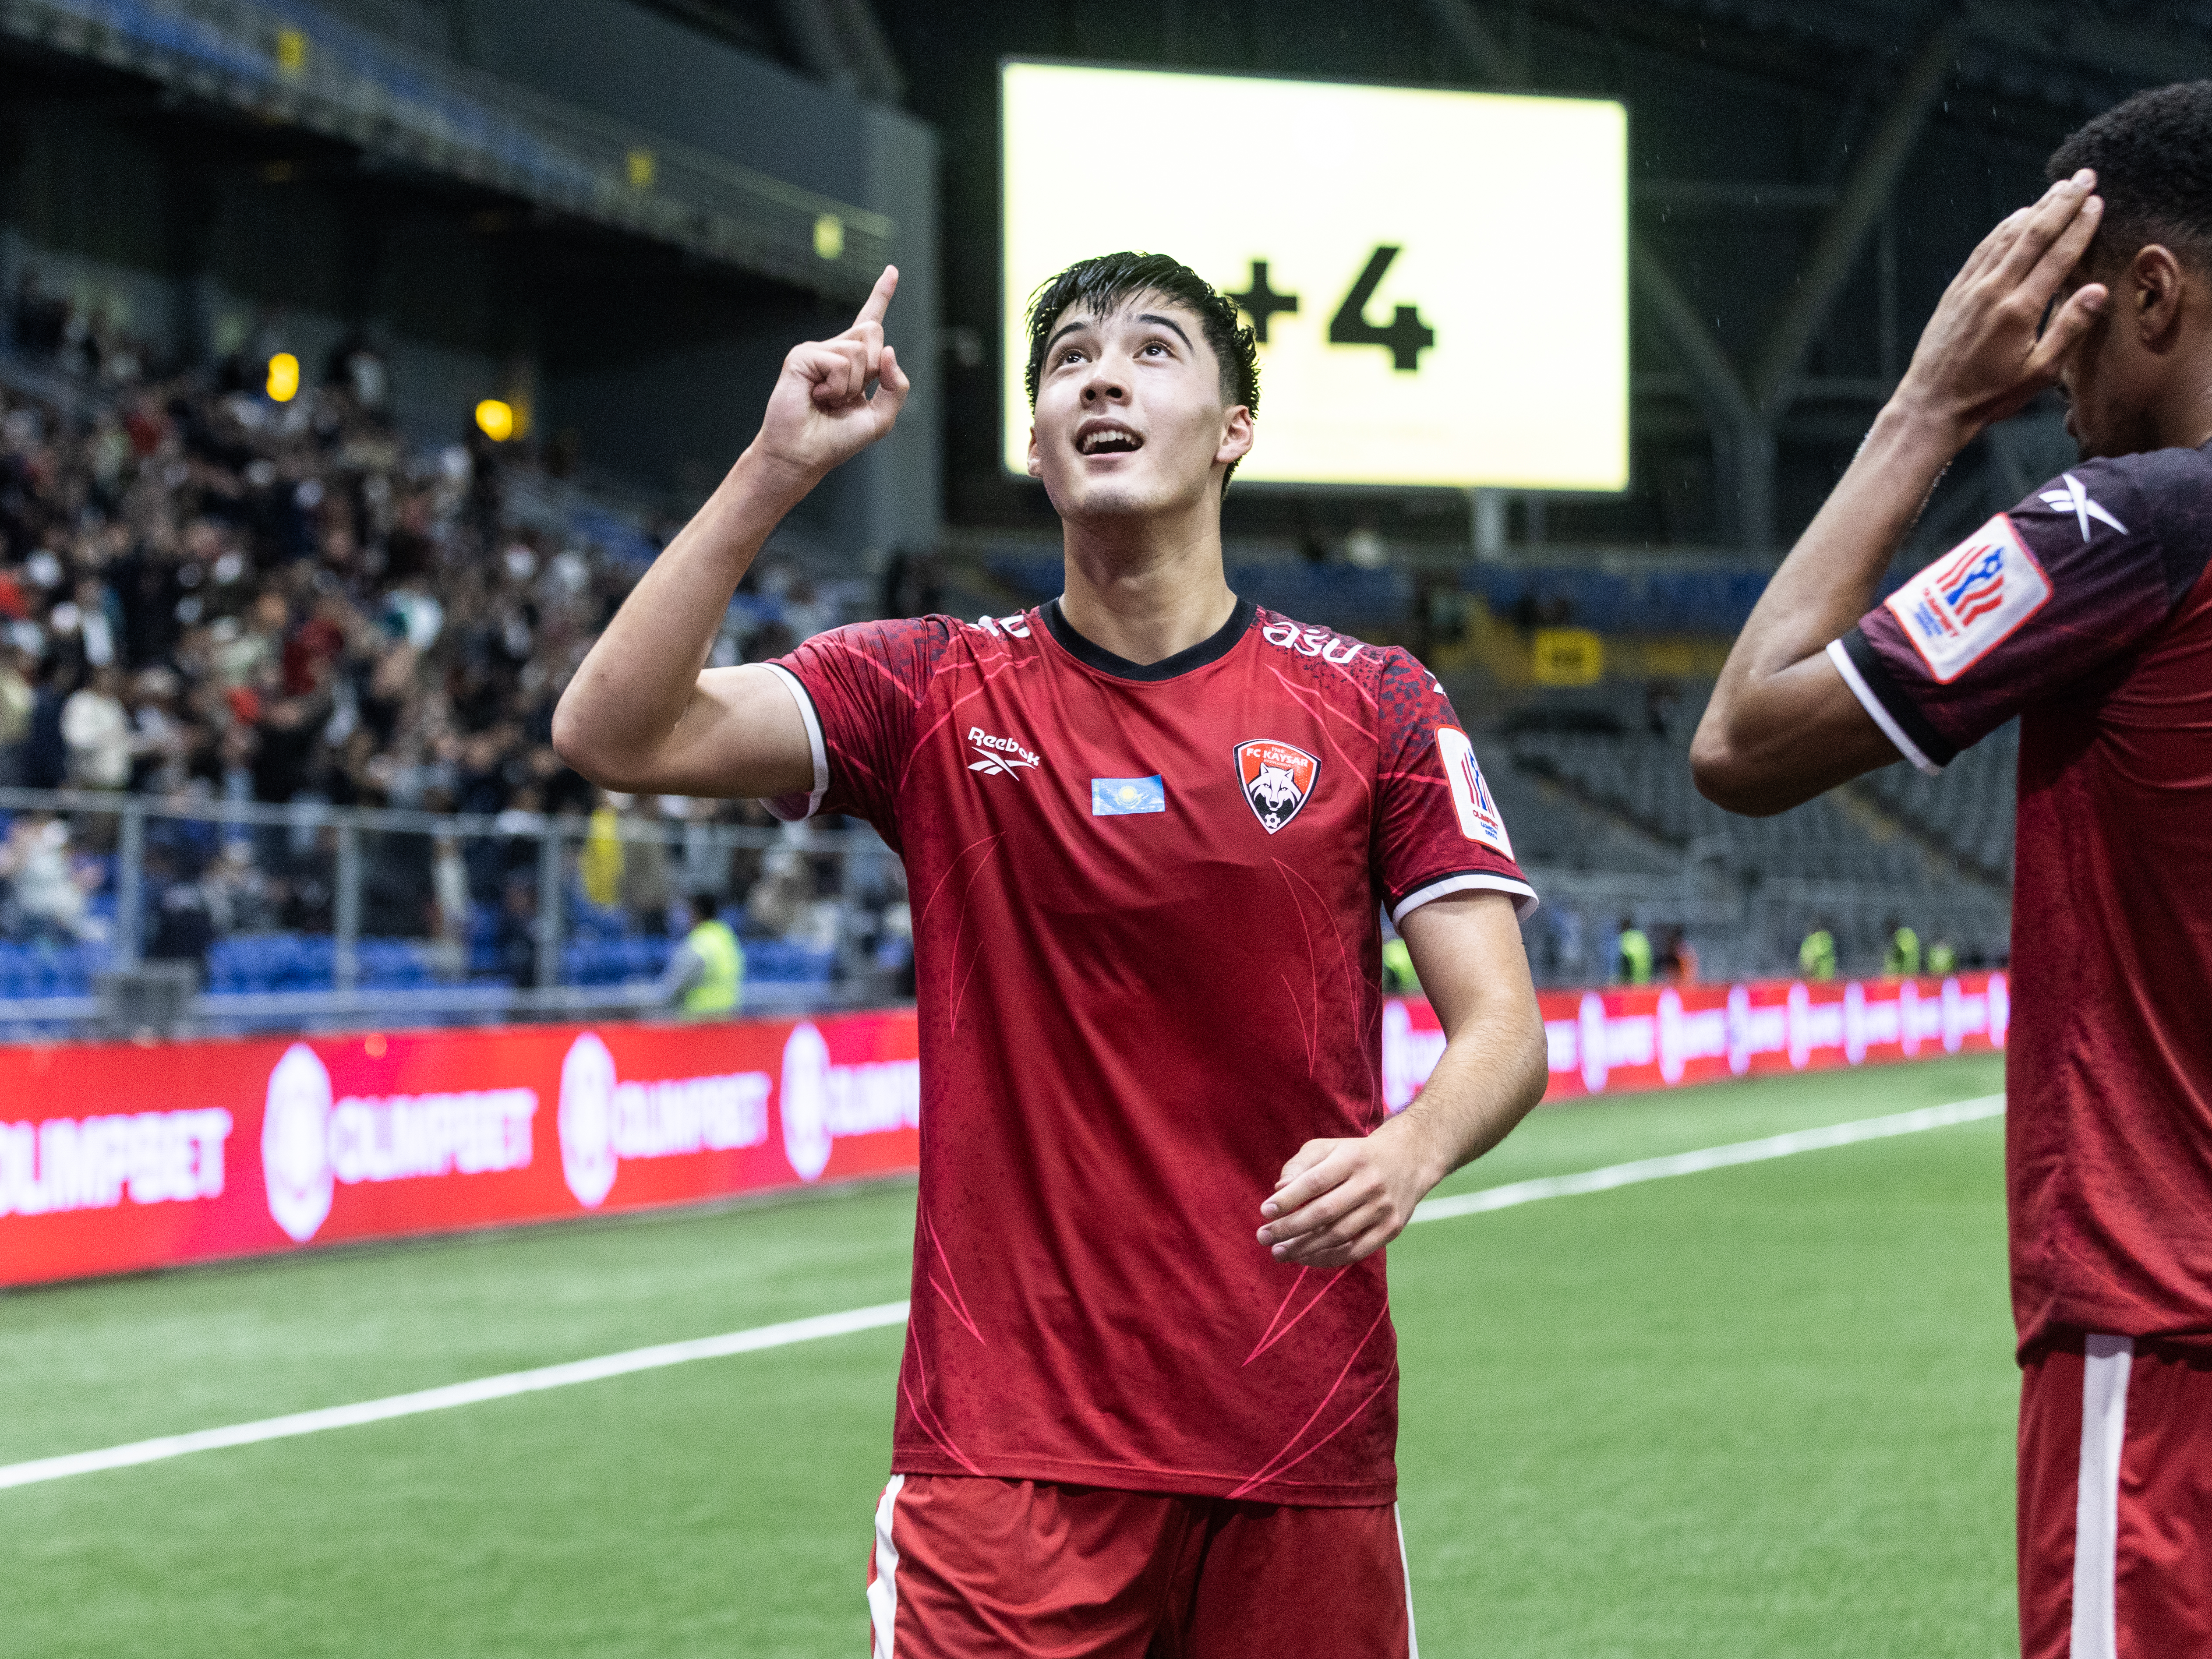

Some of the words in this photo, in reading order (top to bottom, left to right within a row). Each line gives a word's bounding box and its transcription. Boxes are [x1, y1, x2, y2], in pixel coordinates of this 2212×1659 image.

[968, 727, 1040, 766] Reebok
[1246, 748, 1261, 757] FC
[1263, 750, 1308, 767] KAYSAR
[329, 1087, 539, 1184] OLIMPBET
